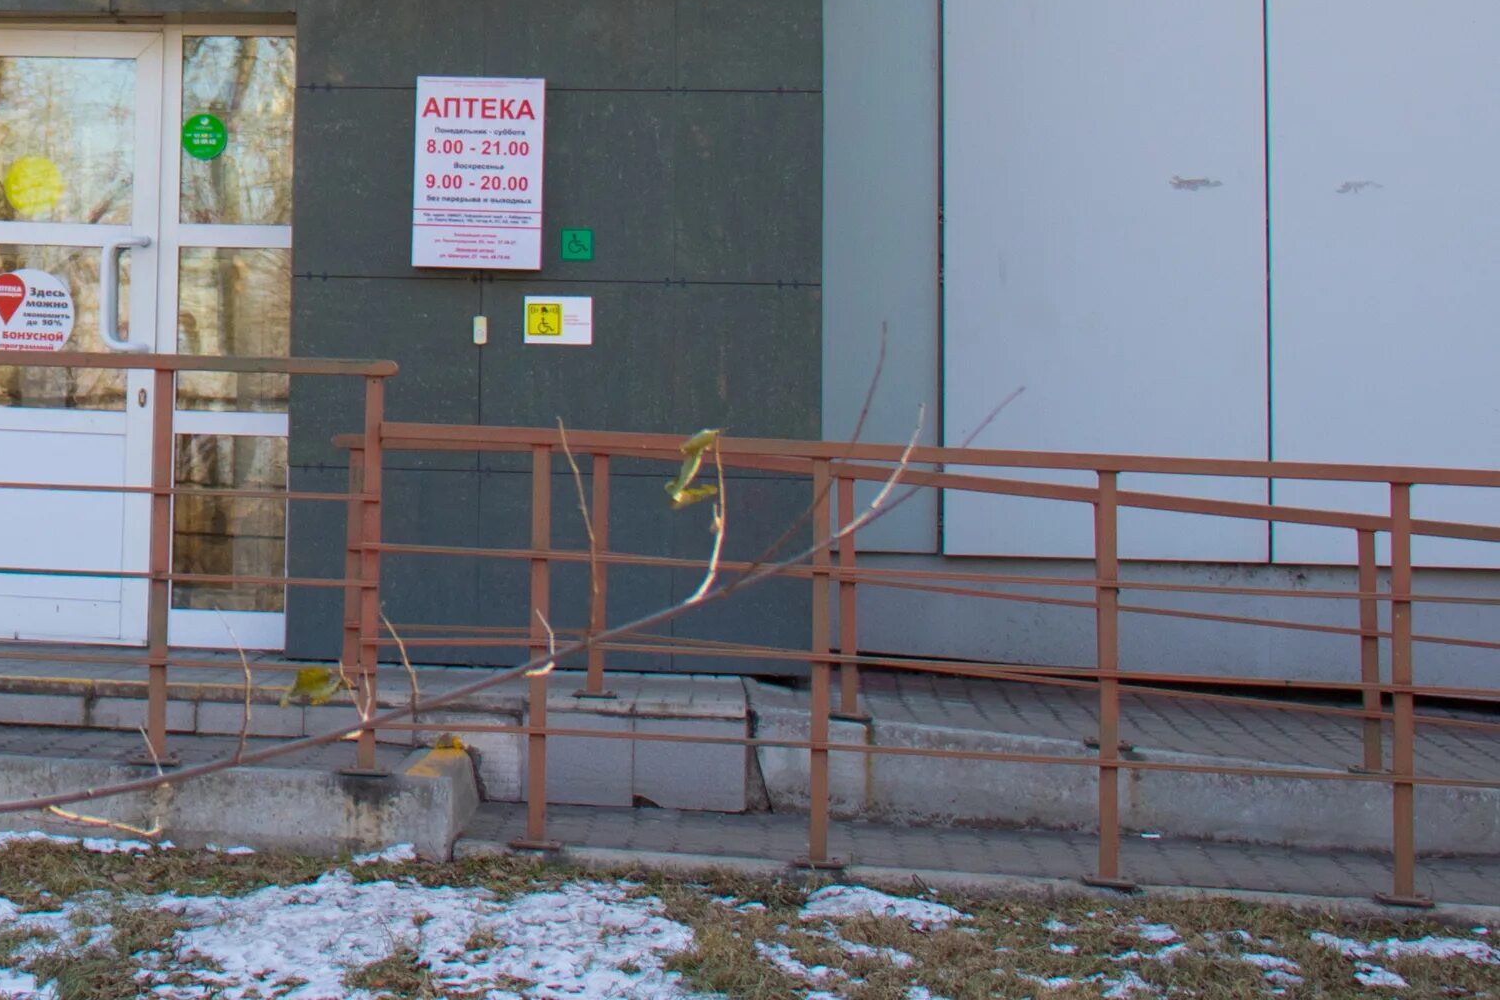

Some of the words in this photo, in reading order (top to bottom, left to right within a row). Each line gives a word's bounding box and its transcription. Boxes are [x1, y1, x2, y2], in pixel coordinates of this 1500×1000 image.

[422, 97, 536, 120] АПТЕКА
[434, 126, 487, 135] Понедельник
[493, 128, 526, 136] суббота
[426, 139, 463, 154] 8.00
[481, 140, 529, 156] 21.00
[453, 161, 505, 171] Воскресенье
[425, 174, 462, 189] 9.00
[481, 175, 529, 191] 20.00
[441, 196, 481, 205] перерыва
[490, 197, 532, 205] выходных
[29, 286, 66, 298] Здесь
[25, 301, 68, 309] можно
[2, 330, 64, 341] БОНУСНОЙ
